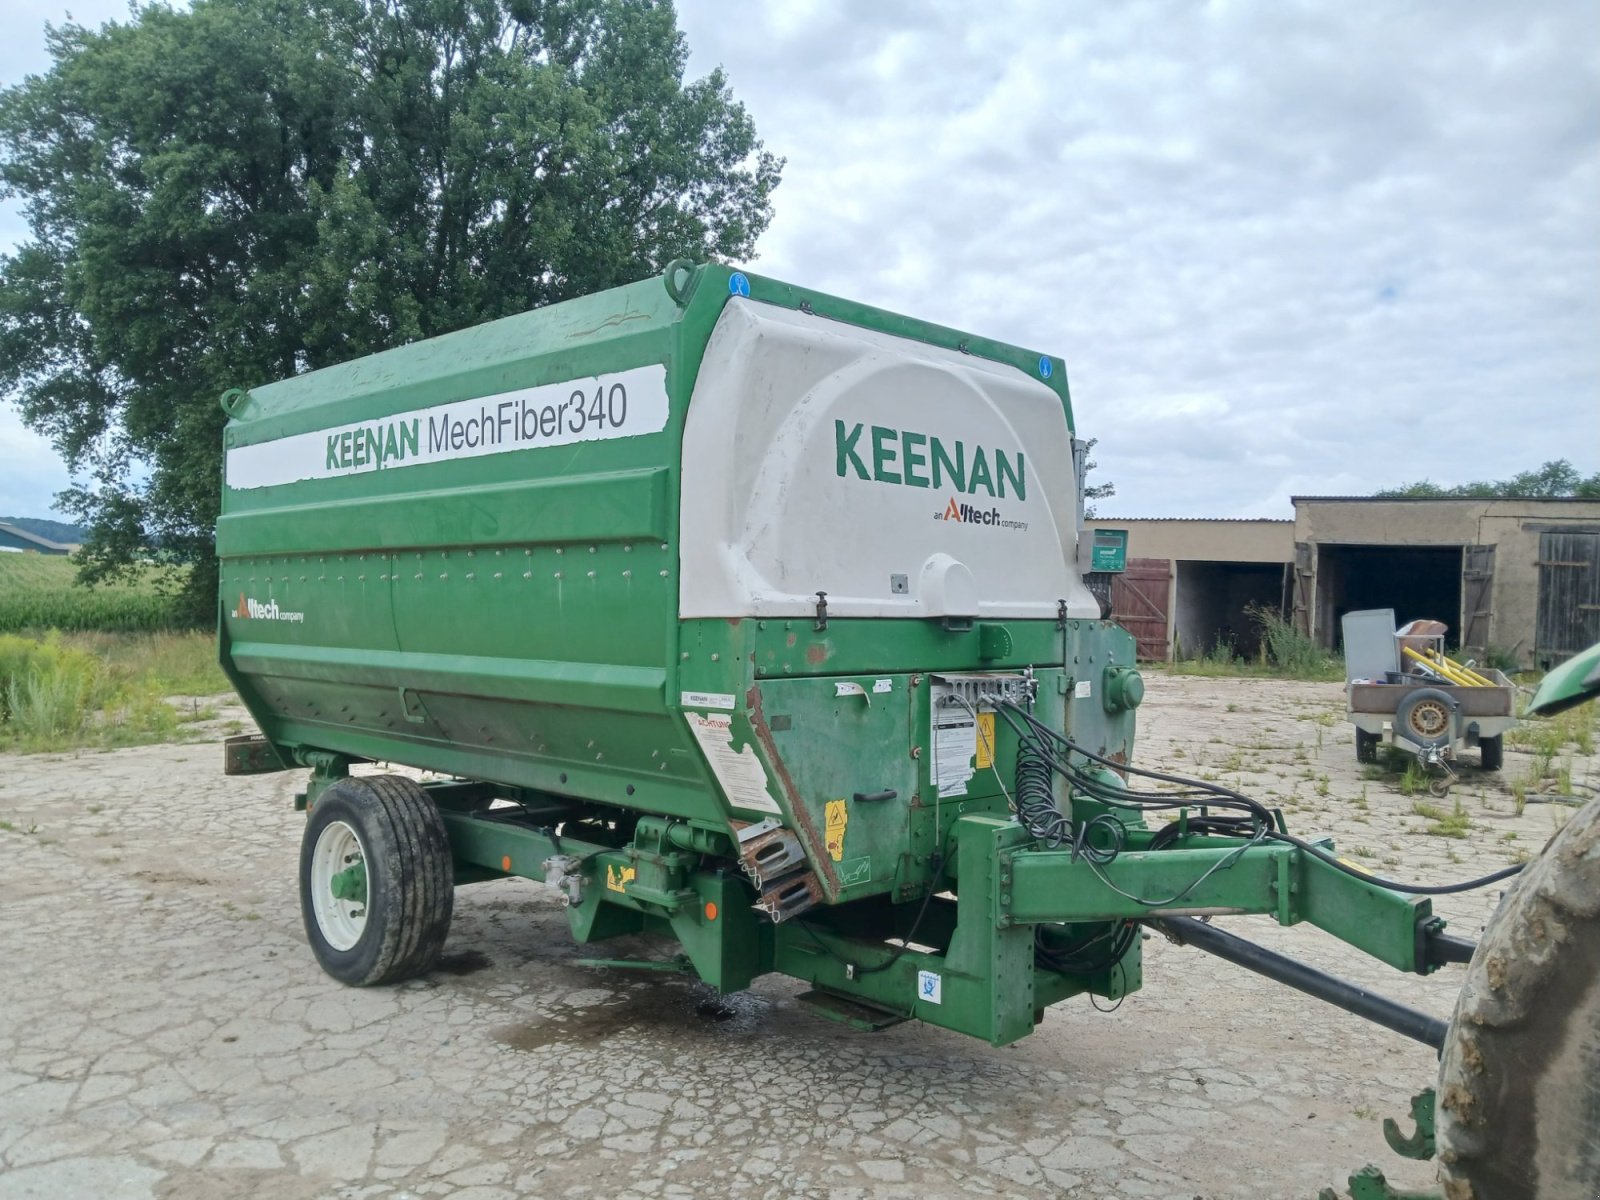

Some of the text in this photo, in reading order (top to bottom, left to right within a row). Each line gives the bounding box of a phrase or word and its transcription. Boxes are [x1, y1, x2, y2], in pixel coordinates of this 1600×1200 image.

[326, 382, 627, 470] KEENAN MechFiber340
[835, 419, 1026, 501] KEENAN
[933, 496, 1028, 532] an Alltech company
[232, 591, 304, 624] an Alltech company
